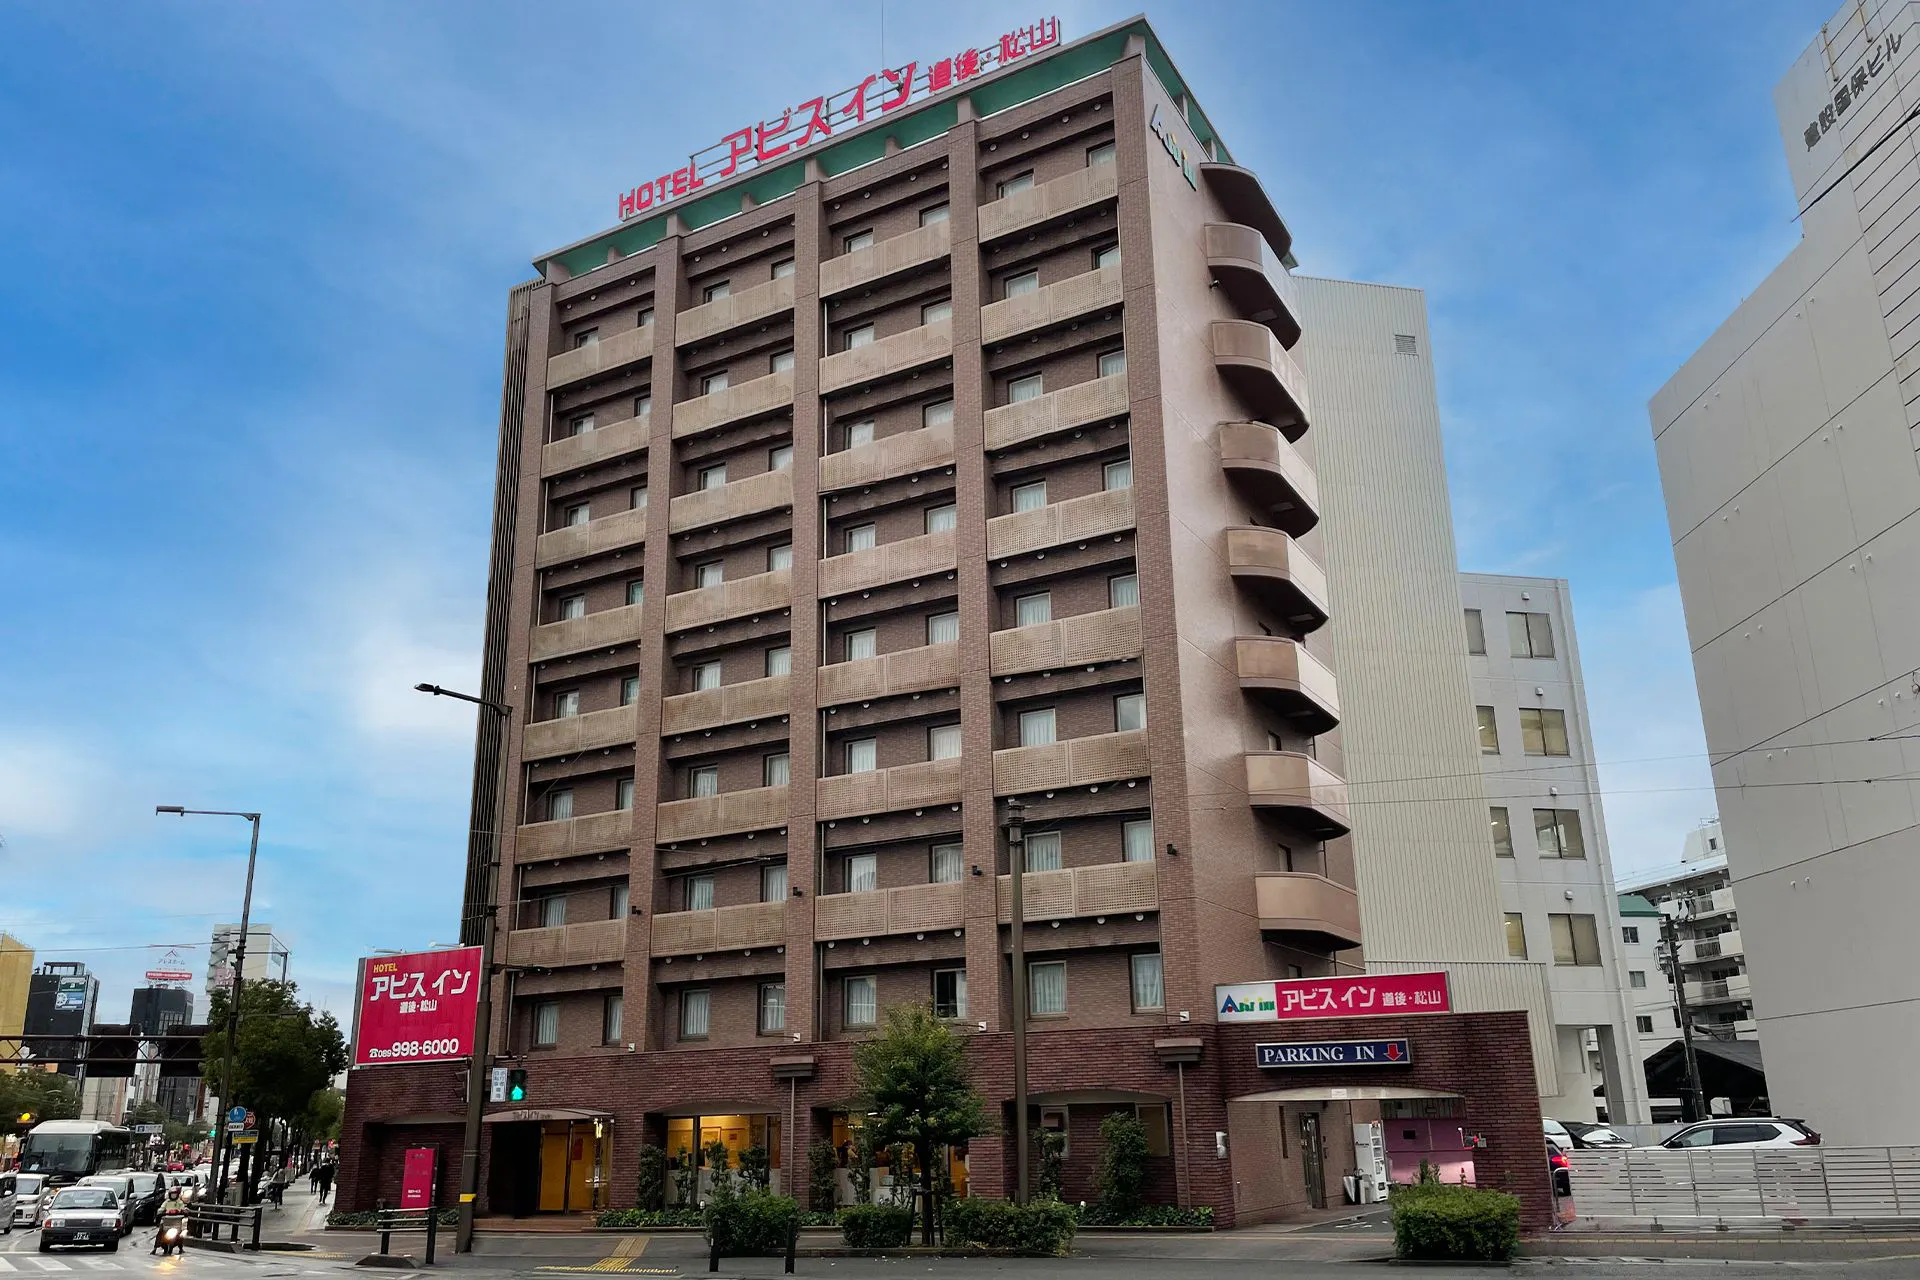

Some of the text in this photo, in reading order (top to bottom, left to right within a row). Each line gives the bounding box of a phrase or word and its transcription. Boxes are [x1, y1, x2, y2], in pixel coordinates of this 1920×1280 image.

[619, 161, 704, 219] HOTEL
[927, 15, 1062, 94] 道後・松山
[373, 962, 398, 974] HOTEL
[1382, 988, 1442, 1007] 道後・松山
[1263, 1045, 1375, 1064] PARKING IN
